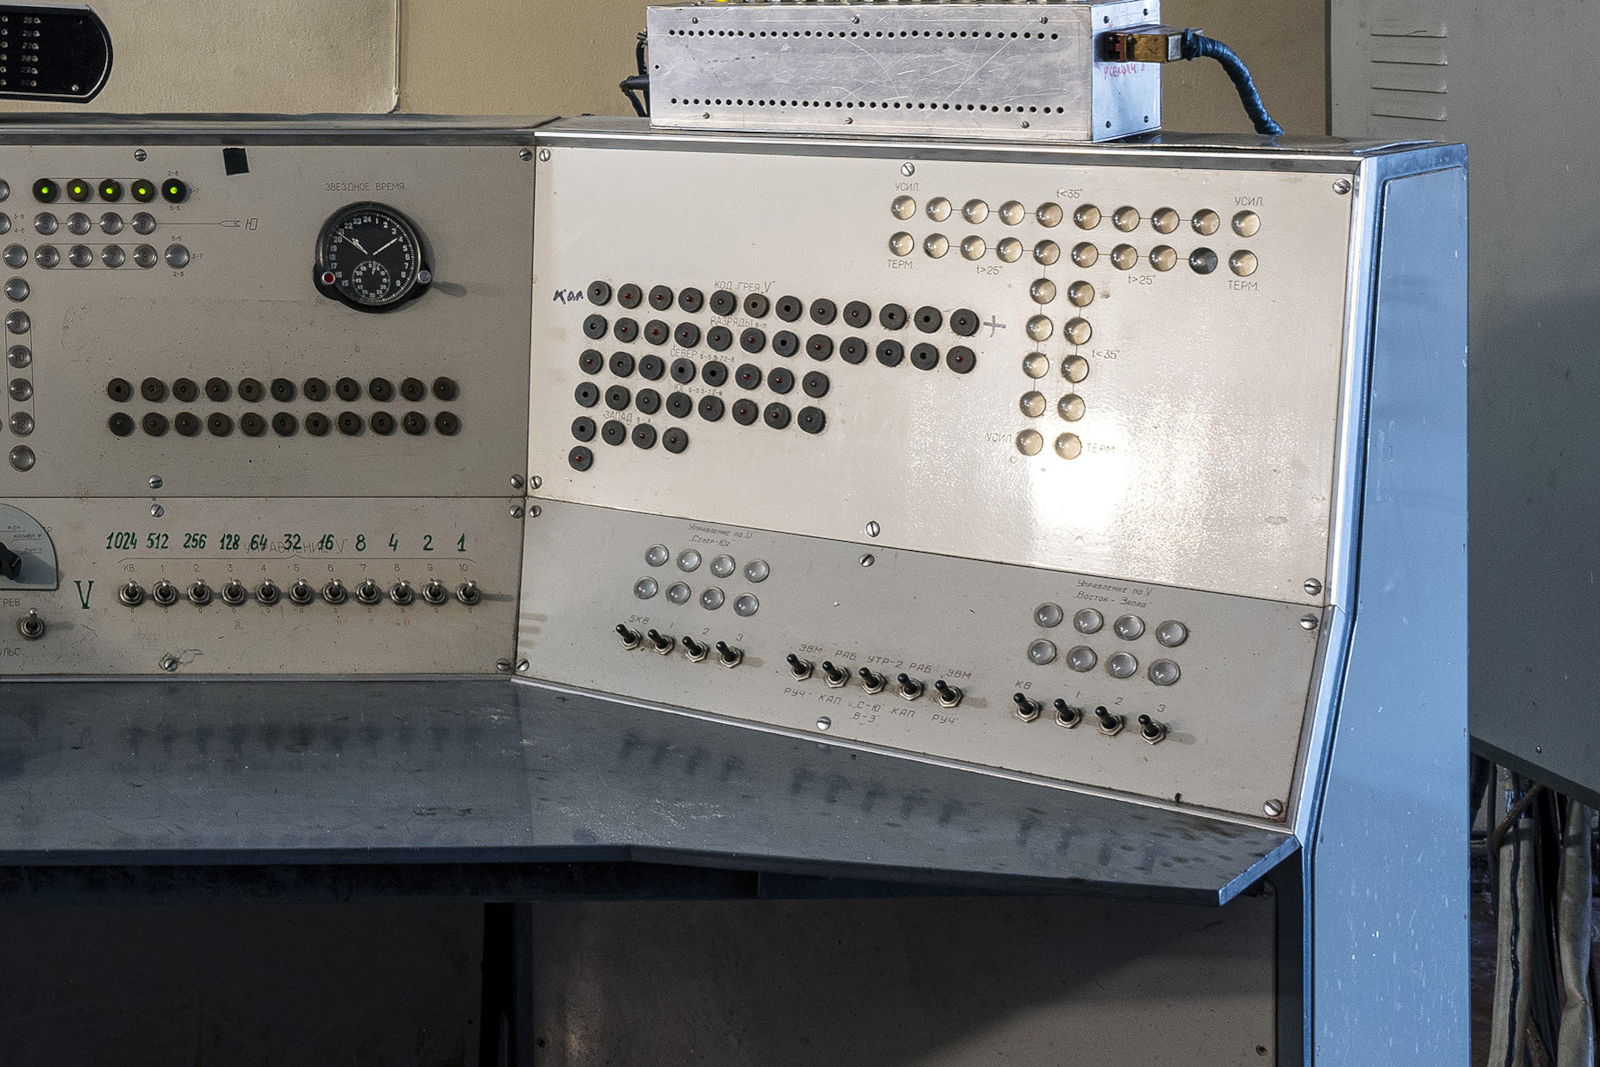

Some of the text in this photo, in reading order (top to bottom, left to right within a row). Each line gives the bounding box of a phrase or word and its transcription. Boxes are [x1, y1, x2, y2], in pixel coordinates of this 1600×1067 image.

[325, 183, 370, 191] ЗВЕЗДНОЕ
[715, 280, 760, 292] КОД ГРЕЯ
[710, 316, 753, 327] РАЗРЯДЫ
[670, 347, 698, 358] СЕВЕР
[603, 411, 633, 423] ЗАПАД
[105, 531, 467, 552] 1024 512 256 128 64 32 16 8 4 2 1
[123, 563, 468, 572] КВ 3 6 8 10
[74, 580, 94, 609] V
[799, 643, 822, 654] ЭВМ
[867, 655, 904, 668] УТР-2
[947, 669, 972, 680] ЭВМ
[1114, 696, 1123, 706] 2
[1156, 703, 1166, 713] 3
